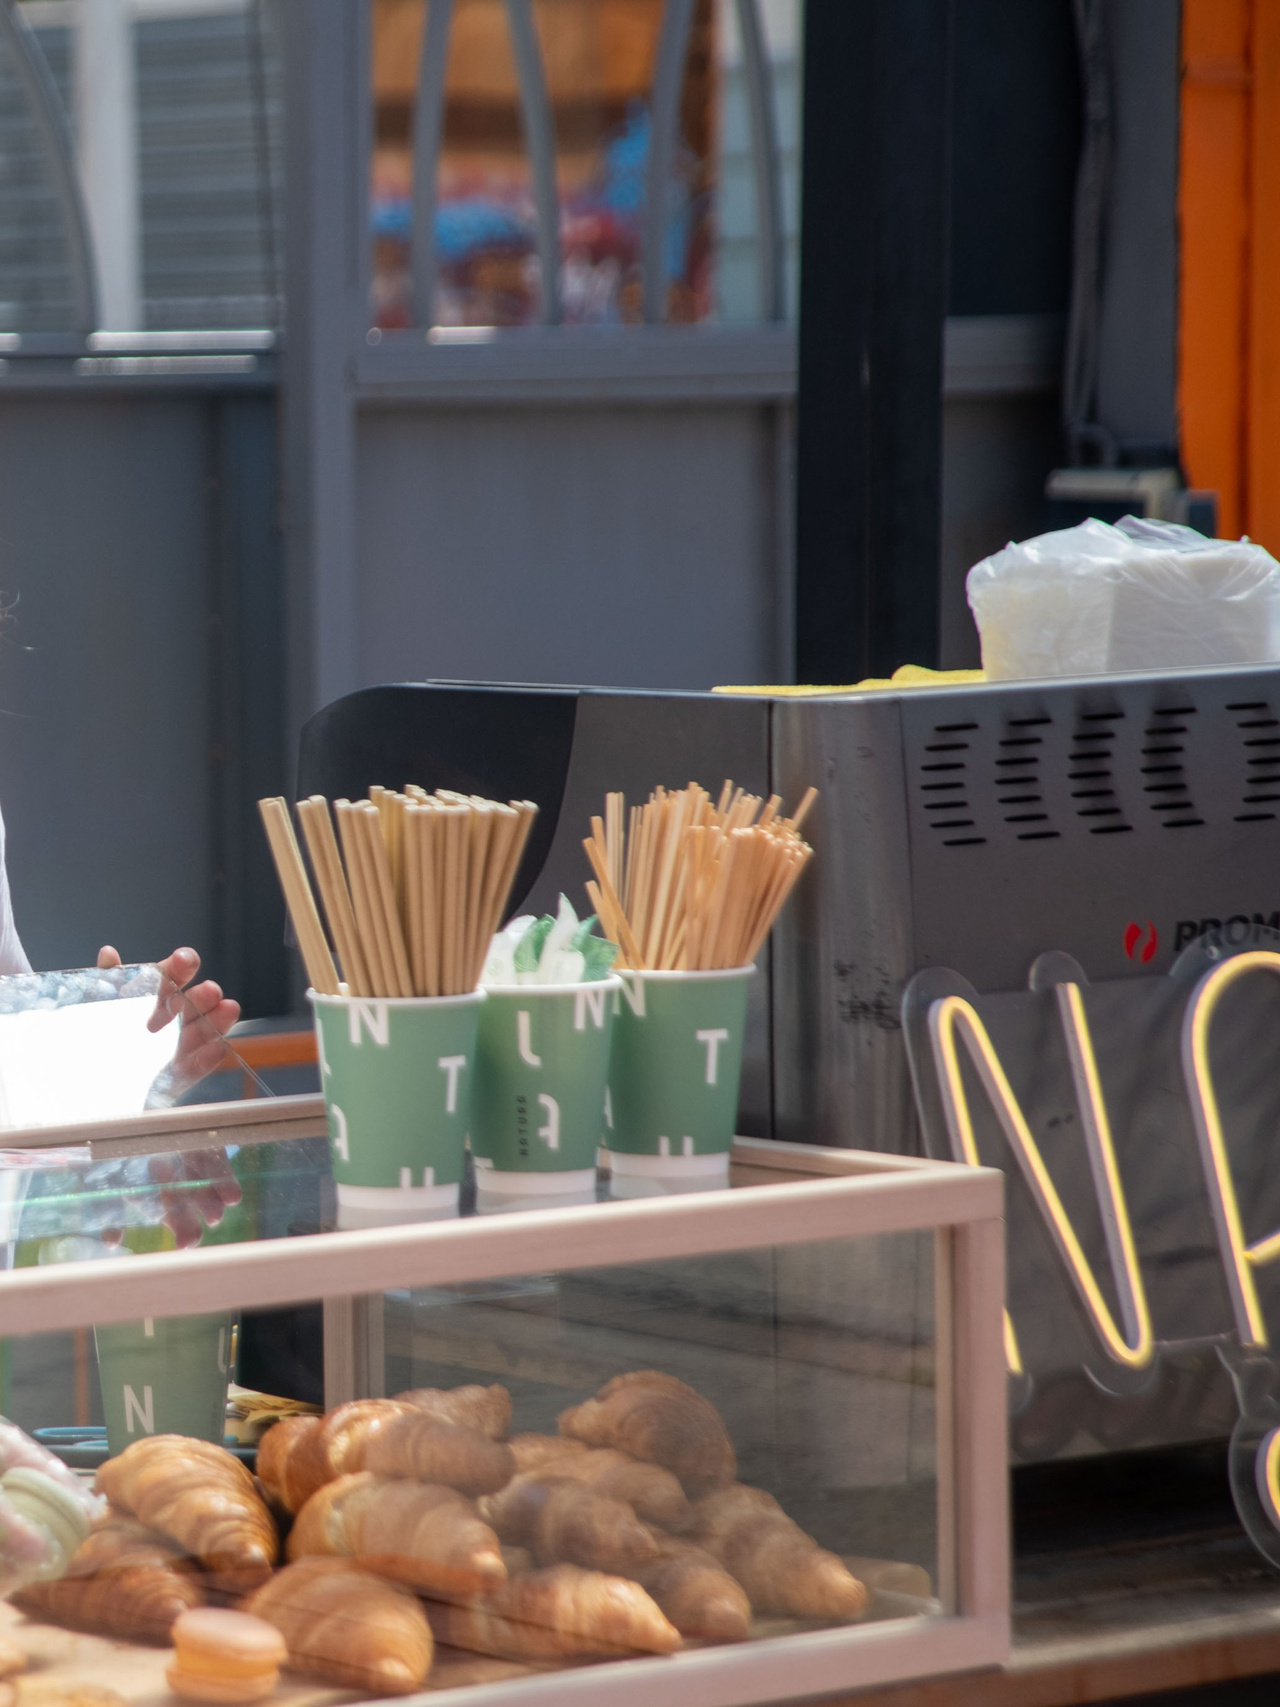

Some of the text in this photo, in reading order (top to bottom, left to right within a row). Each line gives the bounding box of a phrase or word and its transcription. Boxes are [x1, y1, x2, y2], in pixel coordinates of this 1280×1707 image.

[349, 1002, 389, 1044] N
[696, 1028, 728, 1084] T
[438, 1055, 466, 1112] T
[123, 1384, 154, 1433] N
